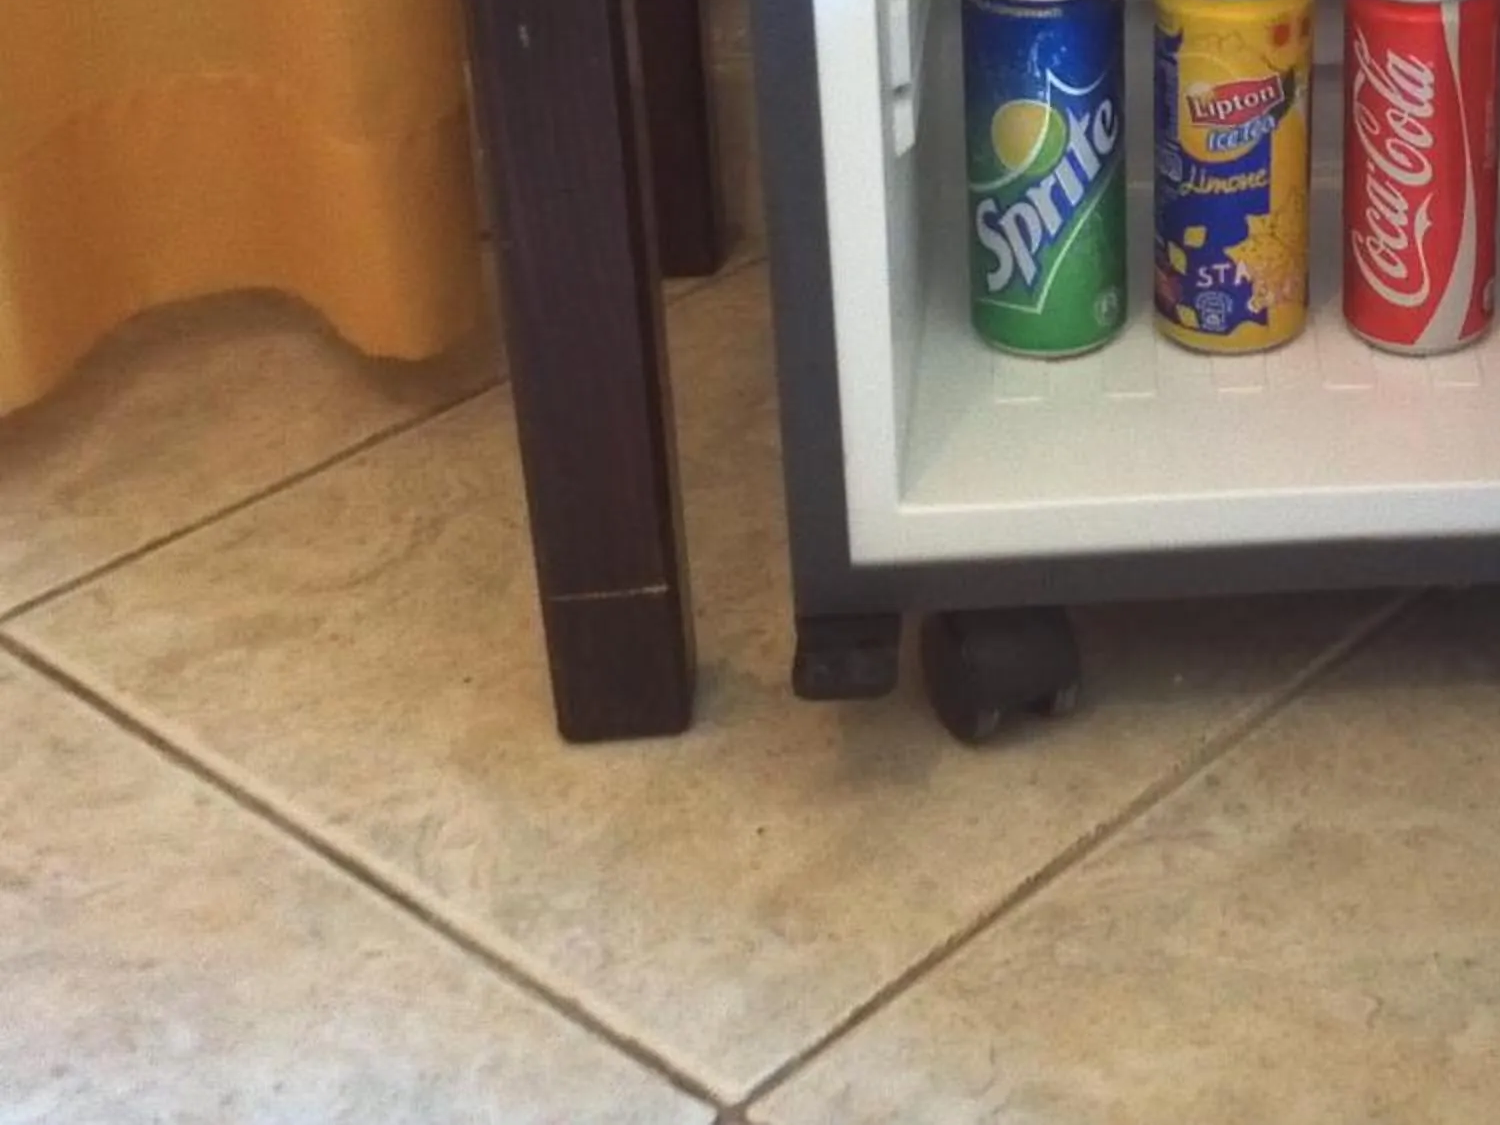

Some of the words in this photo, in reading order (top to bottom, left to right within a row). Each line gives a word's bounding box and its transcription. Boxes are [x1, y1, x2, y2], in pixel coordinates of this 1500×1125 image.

[977, 98, 1119, 292] Sprite
[1193, 83, 1276, 121] Lipton
[1352, 27, 1436, 308] Coca-Cola
